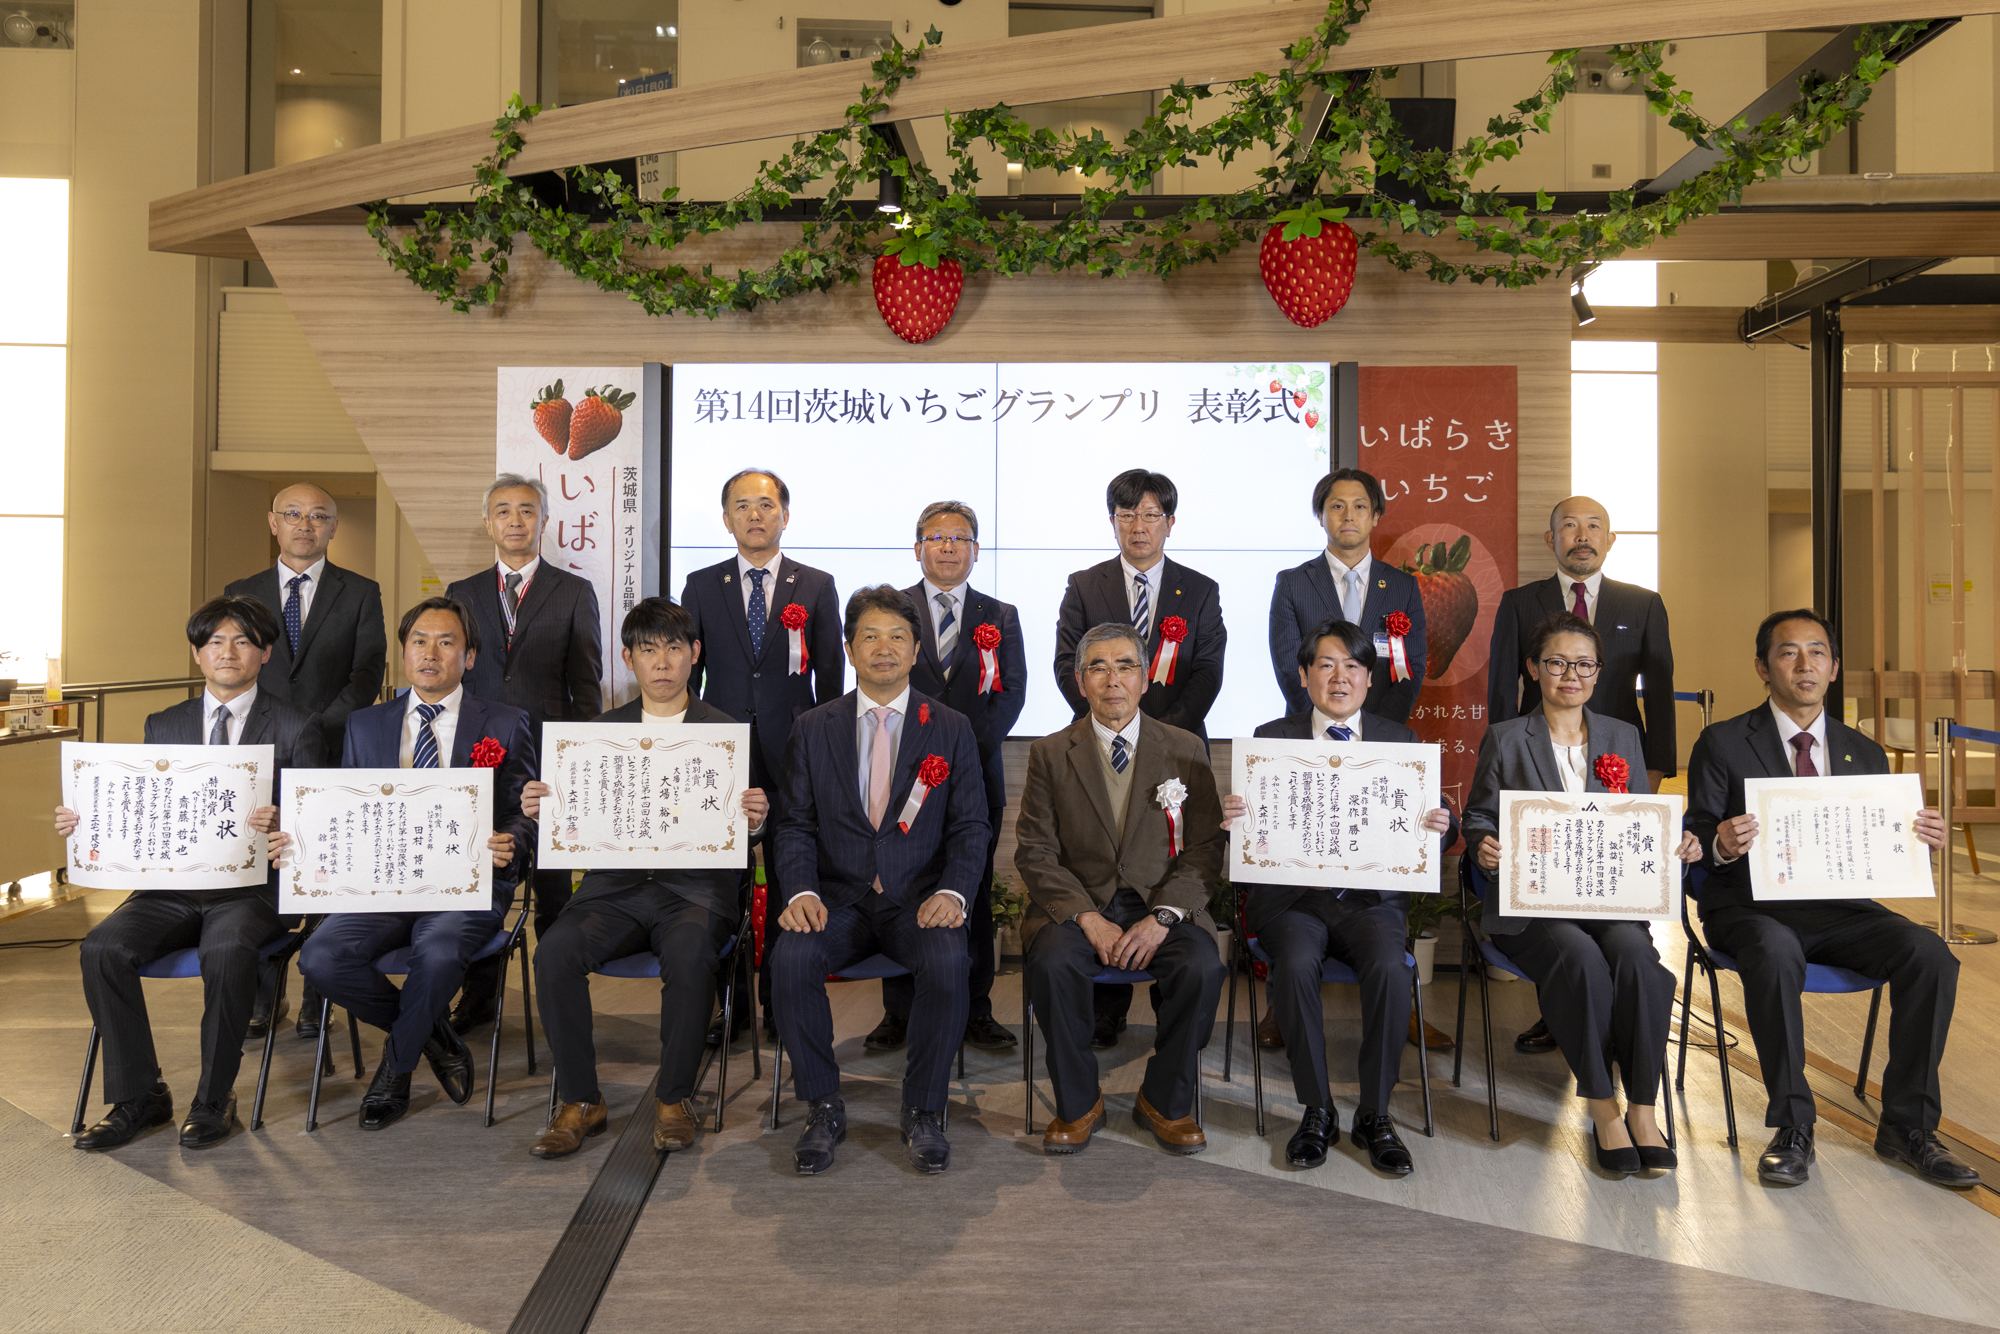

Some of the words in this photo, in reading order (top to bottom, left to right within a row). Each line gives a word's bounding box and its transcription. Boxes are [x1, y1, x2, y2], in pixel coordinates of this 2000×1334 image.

[693, 387, 1160, 426] 第14回茨城いちごグランプリ
[1187, 387, 1302, 426] 表彰式
[1360, 416, 1512, 451] いばらき
[622, 466, 638, 514] 茨城県
[1380, 471, 1494, 503] いちご
[557, 474, 599, 570] いば
[1409, 704, 1486, 720] かれた甘
[599, 756, 610, 815] これを賞します
[691, 757, 702, 787] 特別賞
[701, 769, 720, 811] 賞状
[1379, 776, 1388, 806] 特別賞
[120, 776, 131, 840] これを賞します
[208, 777, 219, 816] 特別賞
[216, 789, 238, 840] 賞状
[626, 755, 636, 839] いちごグランプリにおいて
[638, 756, 652, 839] あなたは第十四回茨城
[1288, 771, 1298, 831] これを賞します
[1315, 772, 1325, 857] いちごグランプリにおいて
[1328, 773, 1342, 857] あなたは第十四回茨城
[1389, 789, 1409, 833] 賞状
[360, 802, 371, 835] 賞します
[446, 820, 460, 856] 賞状
[1632, 822, 1641, 855] 特別賞
[1892, 821, 1904, 854] 賞状
[1564, 819, 1572, 874] これを賞します
[1641, 836, 1655, 874] 賞状
